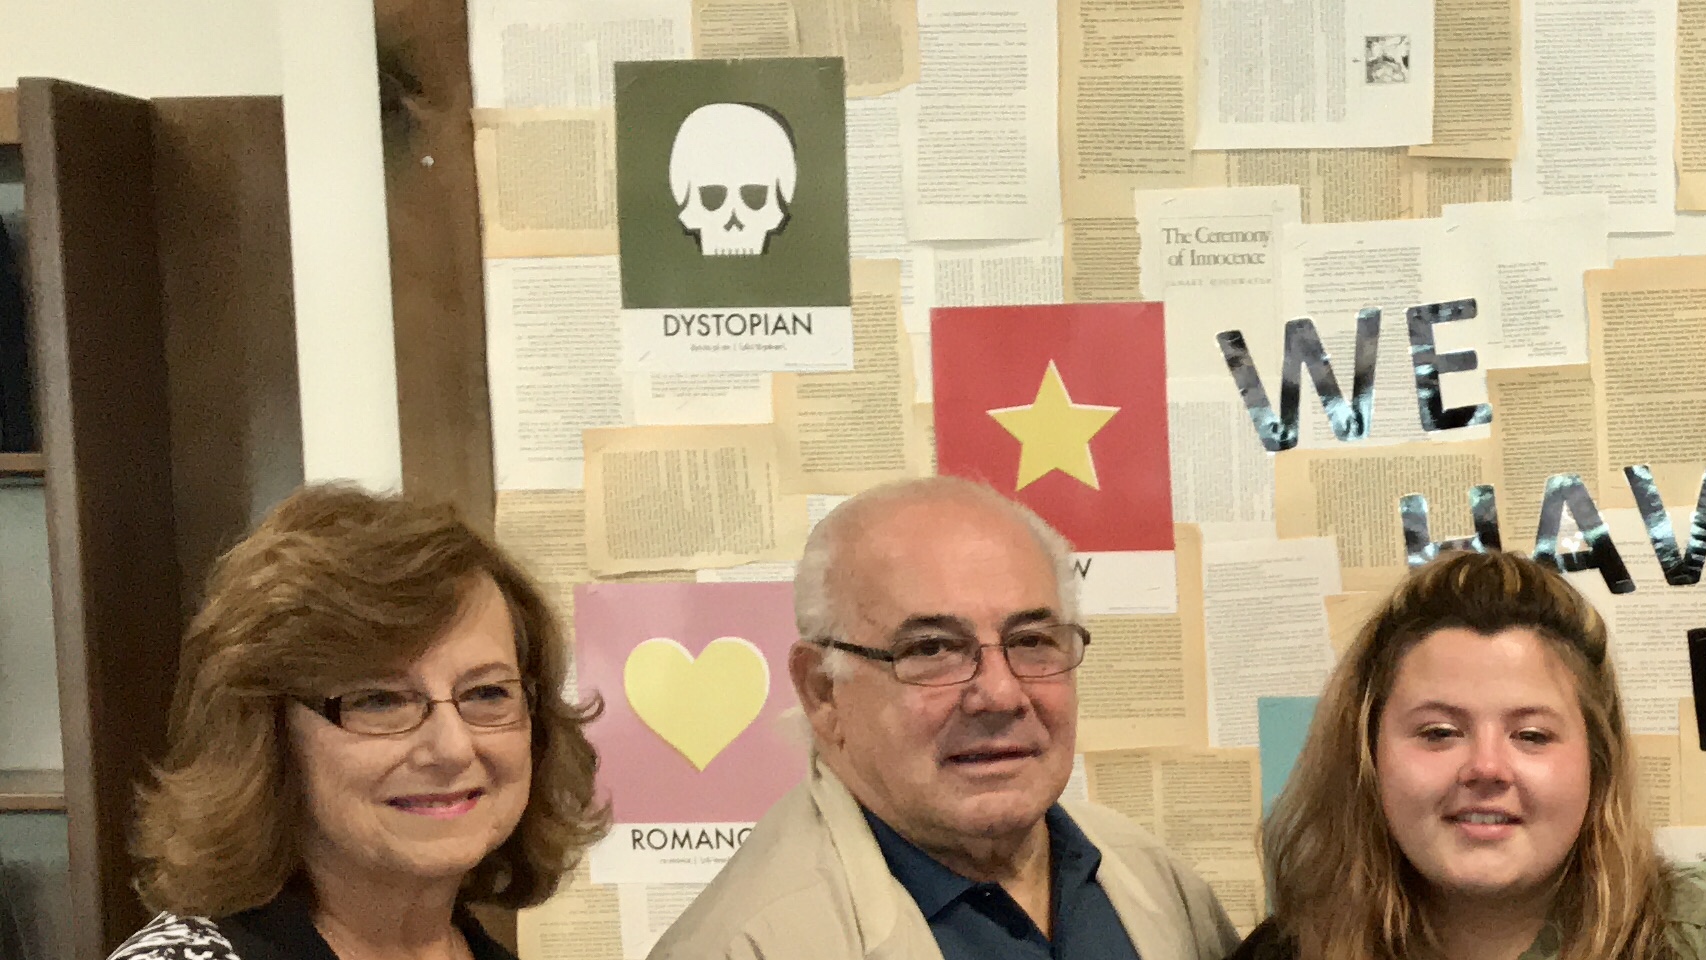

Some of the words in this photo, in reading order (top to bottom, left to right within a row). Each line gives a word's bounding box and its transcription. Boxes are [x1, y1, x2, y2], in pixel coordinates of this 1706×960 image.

[1162, 227, 1192, 245] The
[1195, 226, 1272, 249] Ceremony
[1167, 247, 1187, 267] of
[1190, 249, 1266, 267] Innocence
[663, 312, 814, 337] DYSTOPIAN
[1215, 297, 1494, 453] WE
[631, 827, 753, 851] ROMANC
